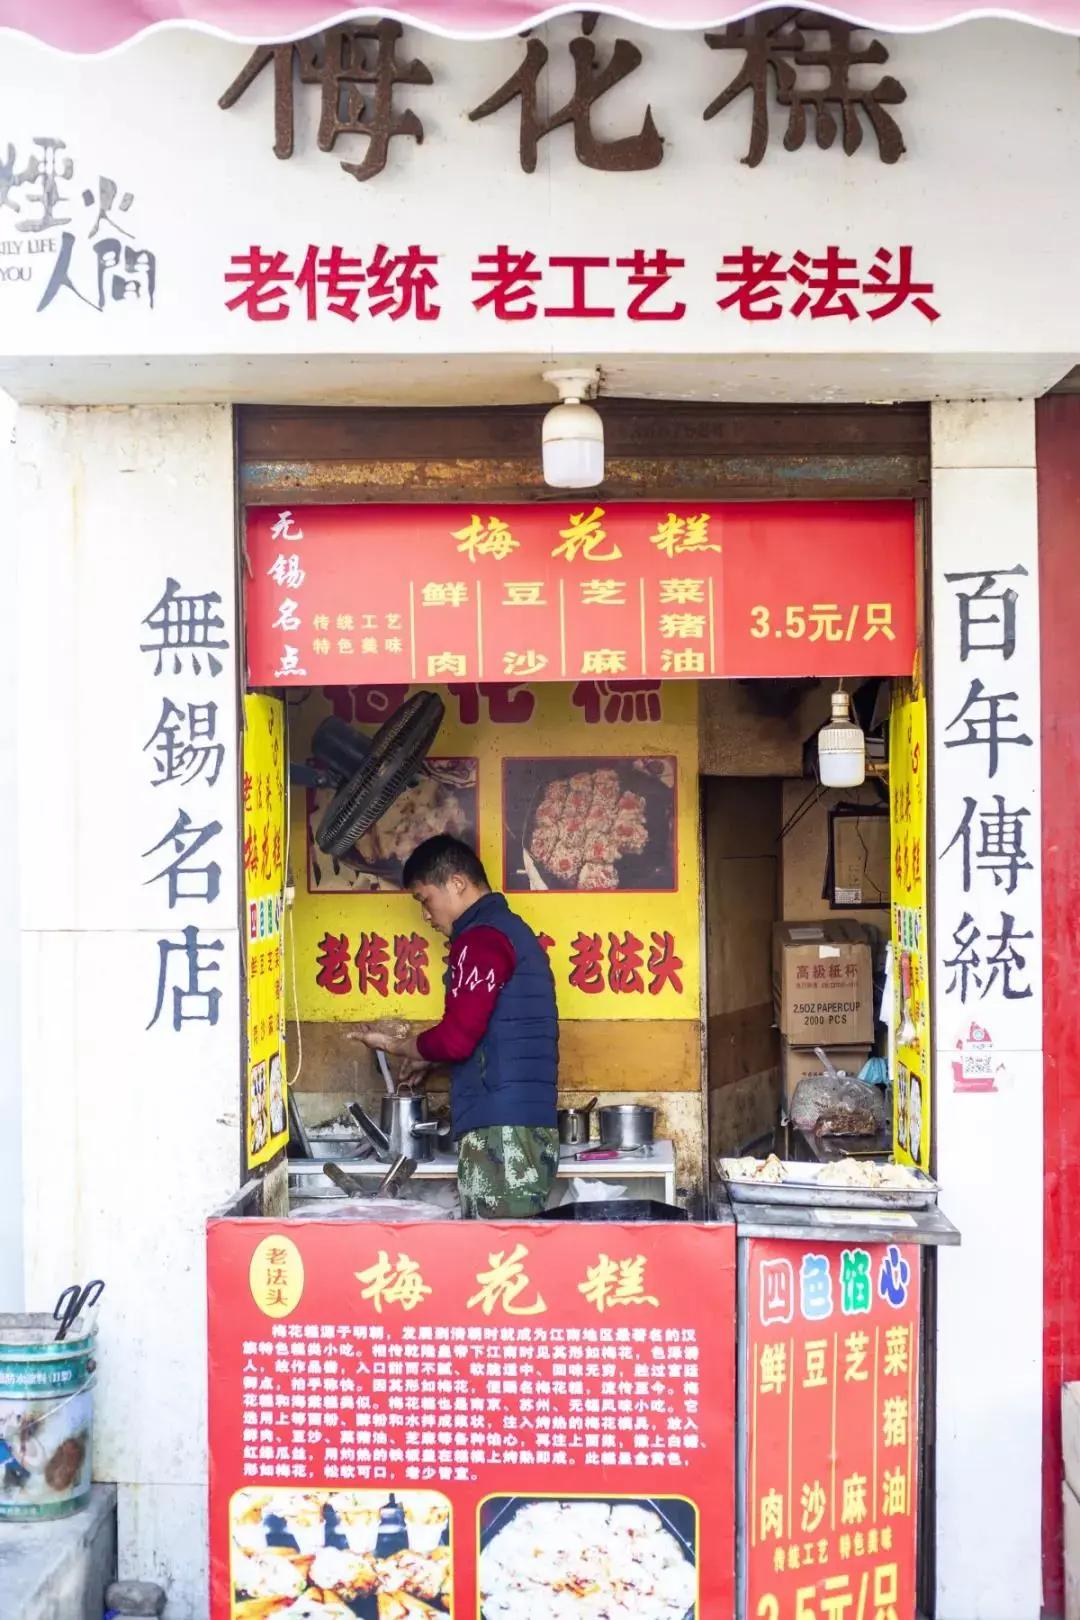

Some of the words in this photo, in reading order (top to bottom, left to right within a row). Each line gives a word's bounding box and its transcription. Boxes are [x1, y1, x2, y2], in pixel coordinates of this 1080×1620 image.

[28, 238, 56, 254] LIFE
[224, 245, 441, 321] 老传统
[471, 245, 686, 322] 老工艺
[716, 245, 941, 323] 老法头
[449, 506, 722, 563] 梅花糕
[266, 511, 307, 679] 无锡名点
[313, 613, 402, 631] 传统工艺
[421, 582, 469, 676] 鲜肉
[502, 582, 549, 675] 豆沙
[580, 579, 627, 673] 芝麻
[658, 579, 707, 673] 菜猪油
[750, 603, 897, 642] 3.5元/只
[139, 577, 230, 1032] 無錫名店
[938, 564, 1034, 1004] 百年傳統
[316, 931, 431, 996] 老传统
[568, 931, 683, 996] 老法头
[804, 1015, 825, 1025] 2000
[829, 1014, 848, 1024] PCS
[265, 1248, 288, 1307] 老法头
[354, 1243, 660, 1316] 梅花糕
[759, 1244, 911, 1327] 四色馅心
[760, 1342, 787, 1541] 鲜肉
[801, 1339, 829, 1533] 豆沙
[841, 1330, 870, 1525] 芝麻
[882, 1325, 909, 1516] 菜猪油
